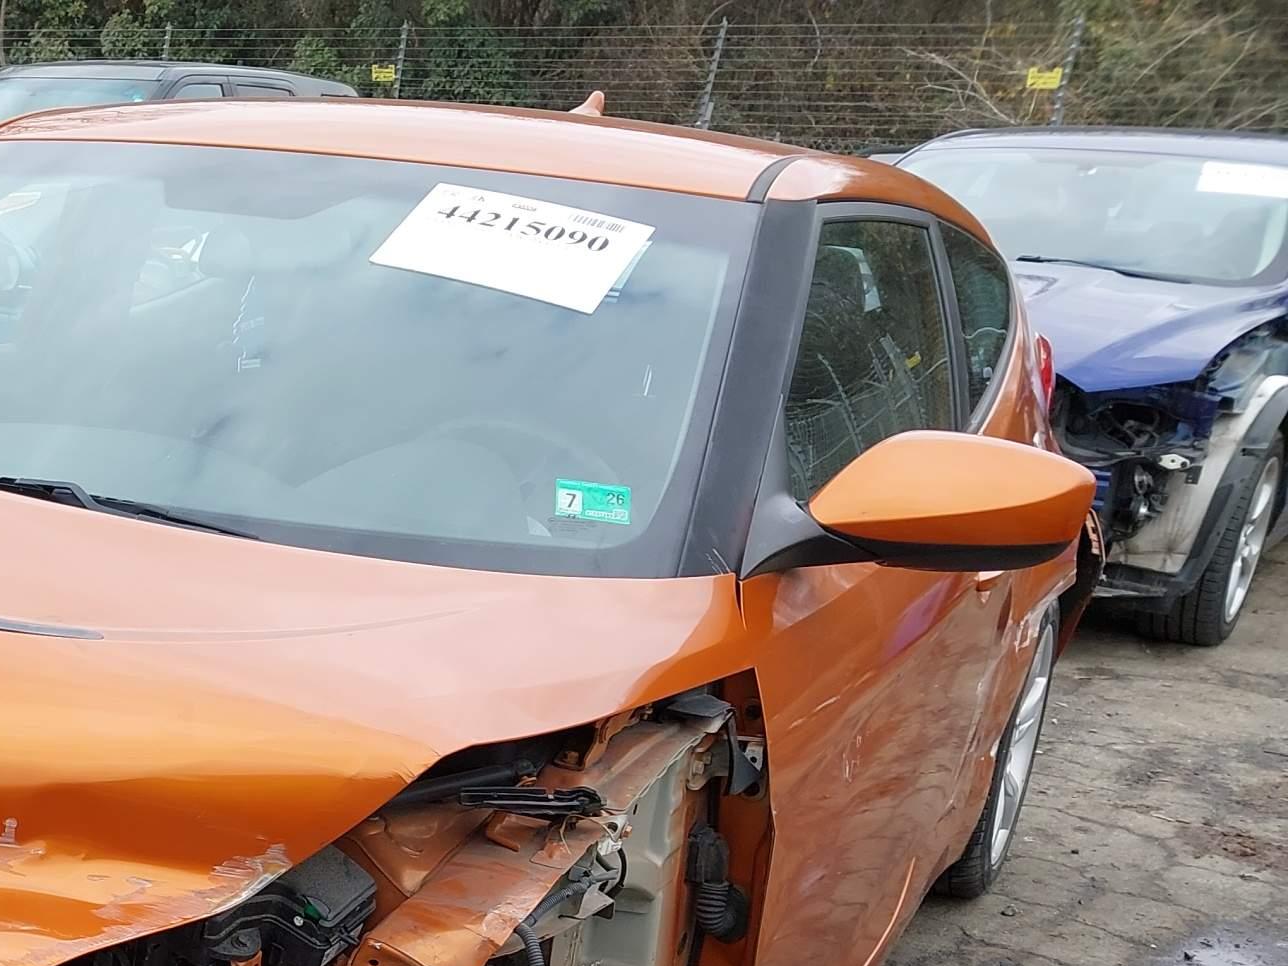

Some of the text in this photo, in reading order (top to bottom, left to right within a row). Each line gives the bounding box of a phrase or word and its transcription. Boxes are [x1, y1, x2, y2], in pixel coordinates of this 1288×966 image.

[436, 204, 611, 253] 44215090
[565, 491, 626, 509] 7 26
